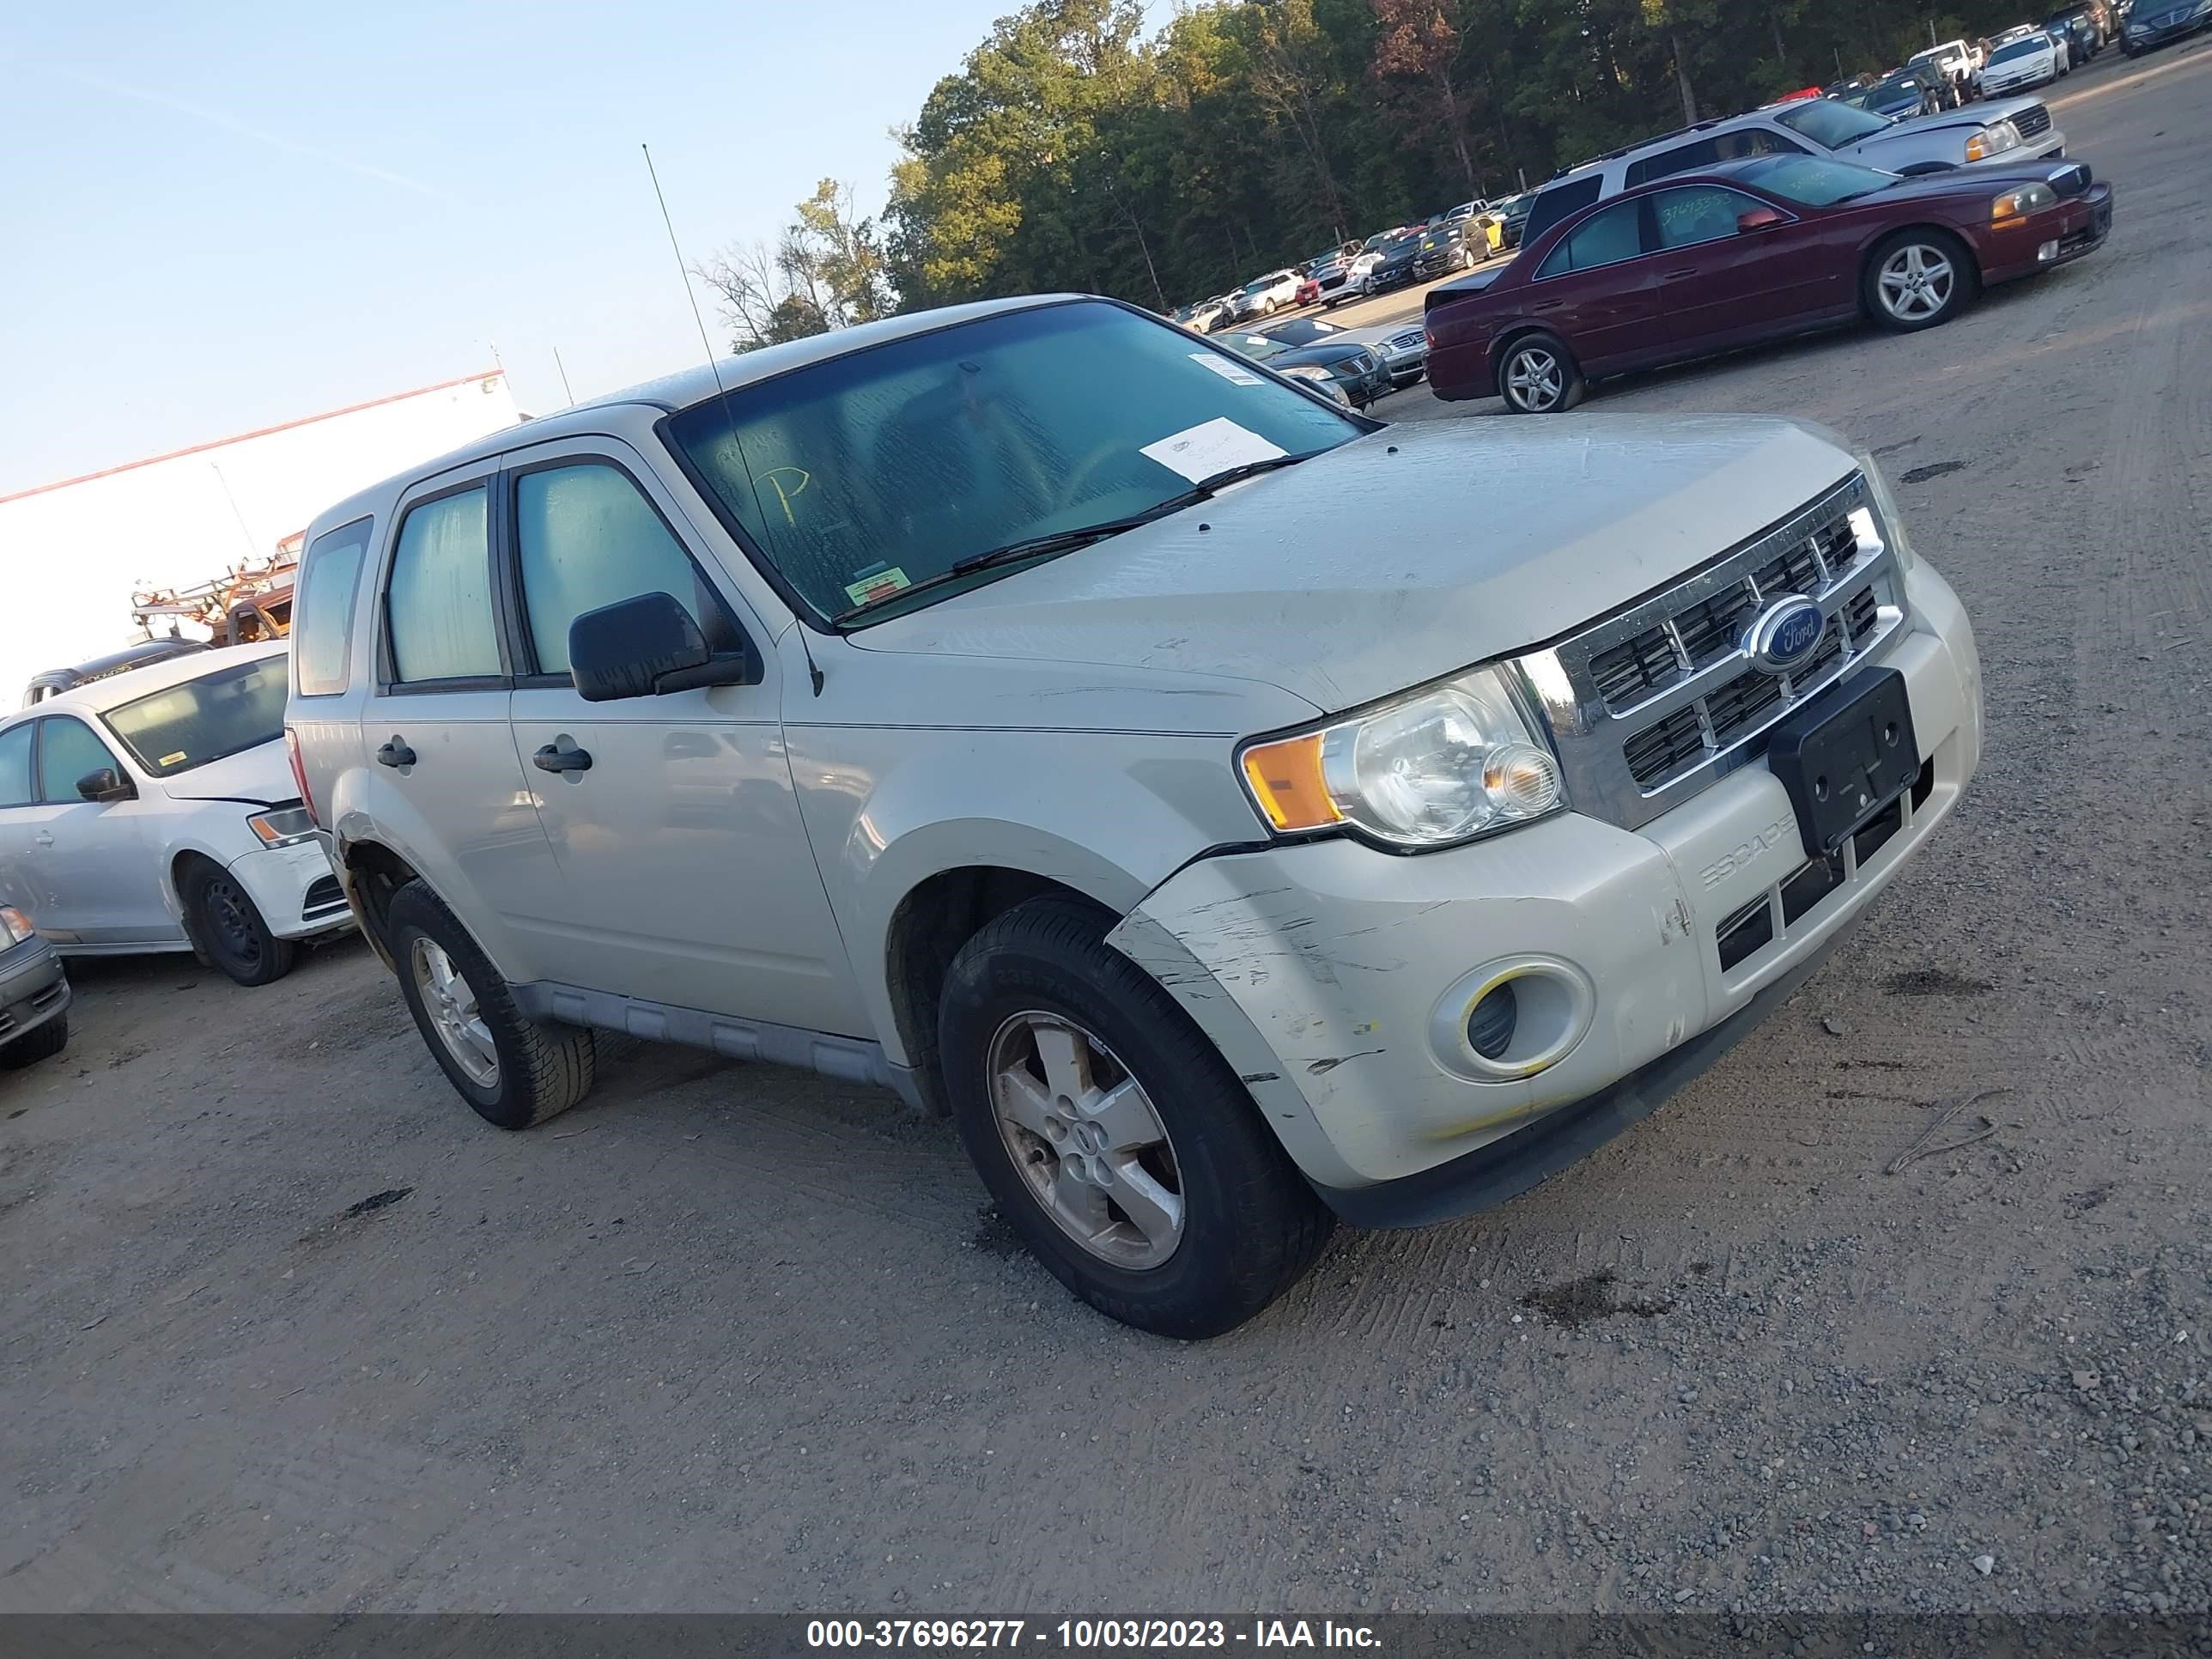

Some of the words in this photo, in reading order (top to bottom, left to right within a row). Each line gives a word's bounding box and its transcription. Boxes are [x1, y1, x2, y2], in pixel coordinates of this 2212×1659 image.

[753, 466, 810, 528] P
[1782, 613, 1814, 653] Ford
[1699, 811, 1796, 892] ESCAPE
